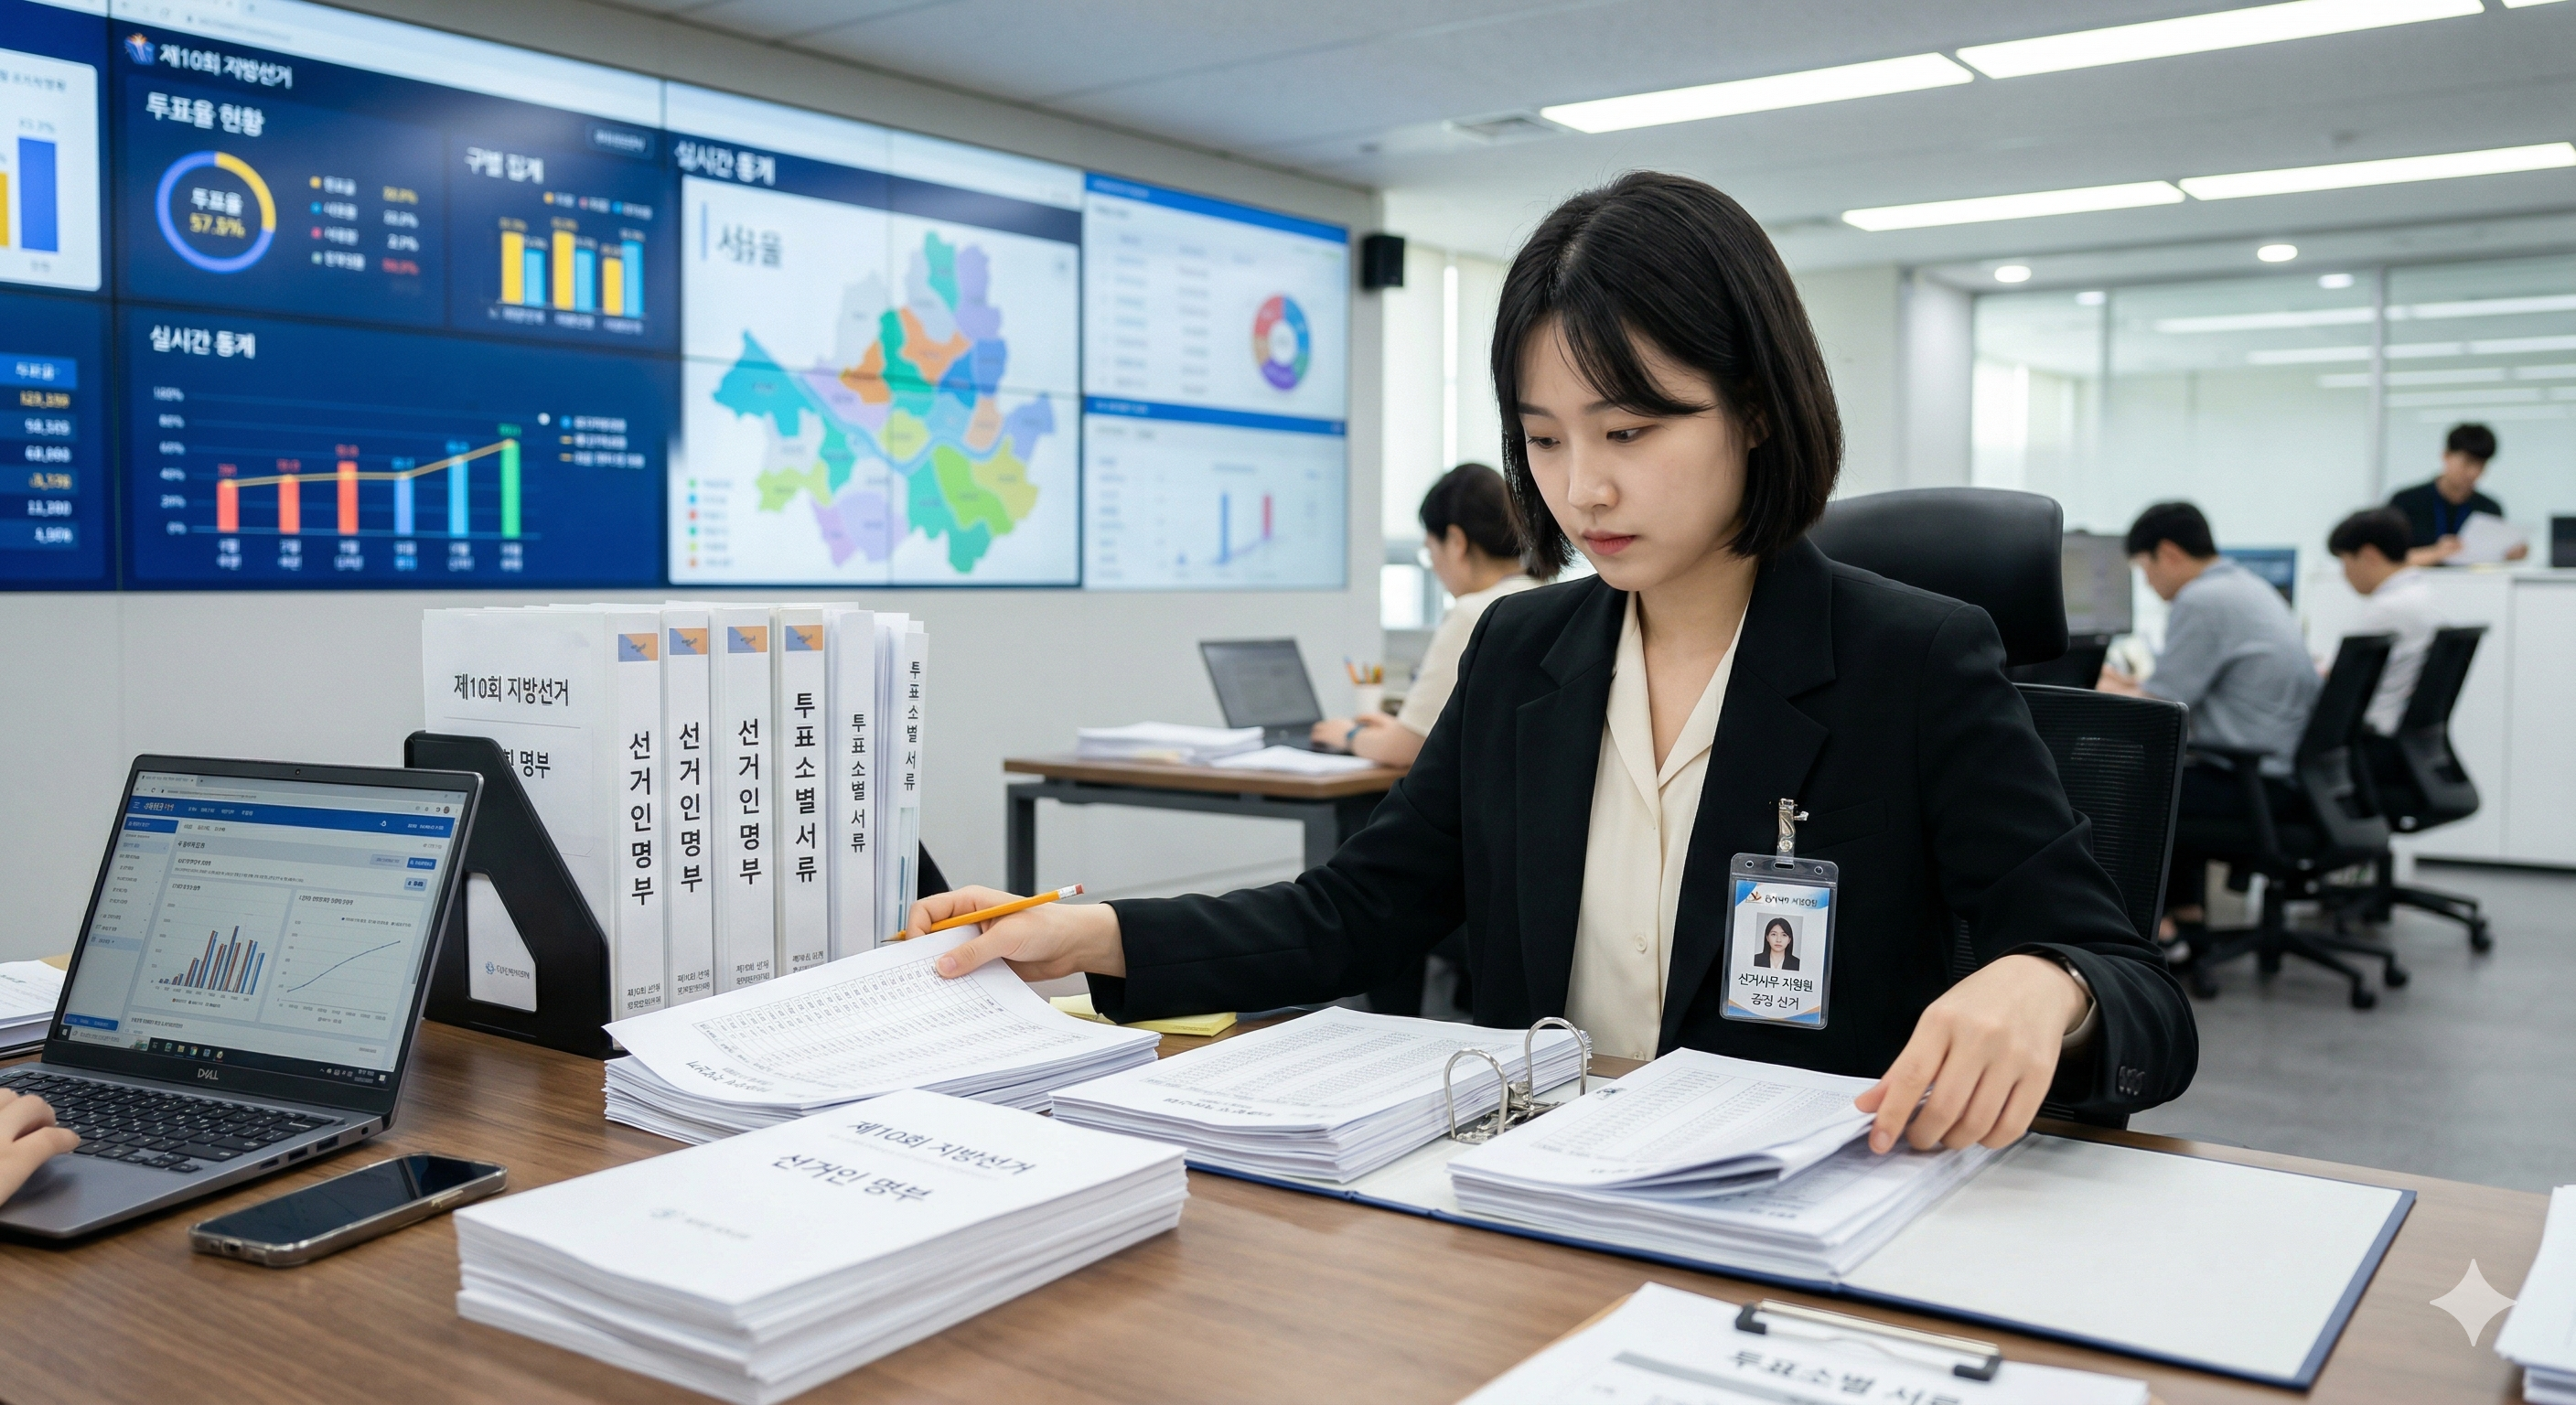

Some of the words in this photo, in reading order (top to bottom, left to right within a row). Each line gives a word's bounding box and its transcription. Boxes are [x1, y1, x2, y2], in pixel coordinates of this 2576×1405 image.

[159, 44, 221, 76] 제10회
[223, 55, 293, 89] 지방선거
[146, 91, 217, 129] 투표율
[190, 188, 244, 217] 투표율
[150, 325, 212, 355] 실시간
[214, 330, 256, 359] 통계
[454, 673, 502, 702] 제10회
[508, 677, 569, 707] 지방선거
[907, 661, 921, 744] 투표소별
[520, 750, 551, 779] 명부
[851, 713, 866, 801] 투표소별
[903, 750, 916, 792] 서류
[629, 731, 654, 906] 선거인명부
[679, 722, 703, 893] 선거인명부
[738, 718, 762, 885] 선거인명부
[851, 809, 866, 853] 서류
[847, 1121, 933, 1149] 제10회
[928, 1142, 1036, 1175] 지방선거
[772, 1154, 872, 1186] 선거인
[864, 1178, 934, 1202] 명부
[1730, 1350, 1876, 1395] 투표소별
